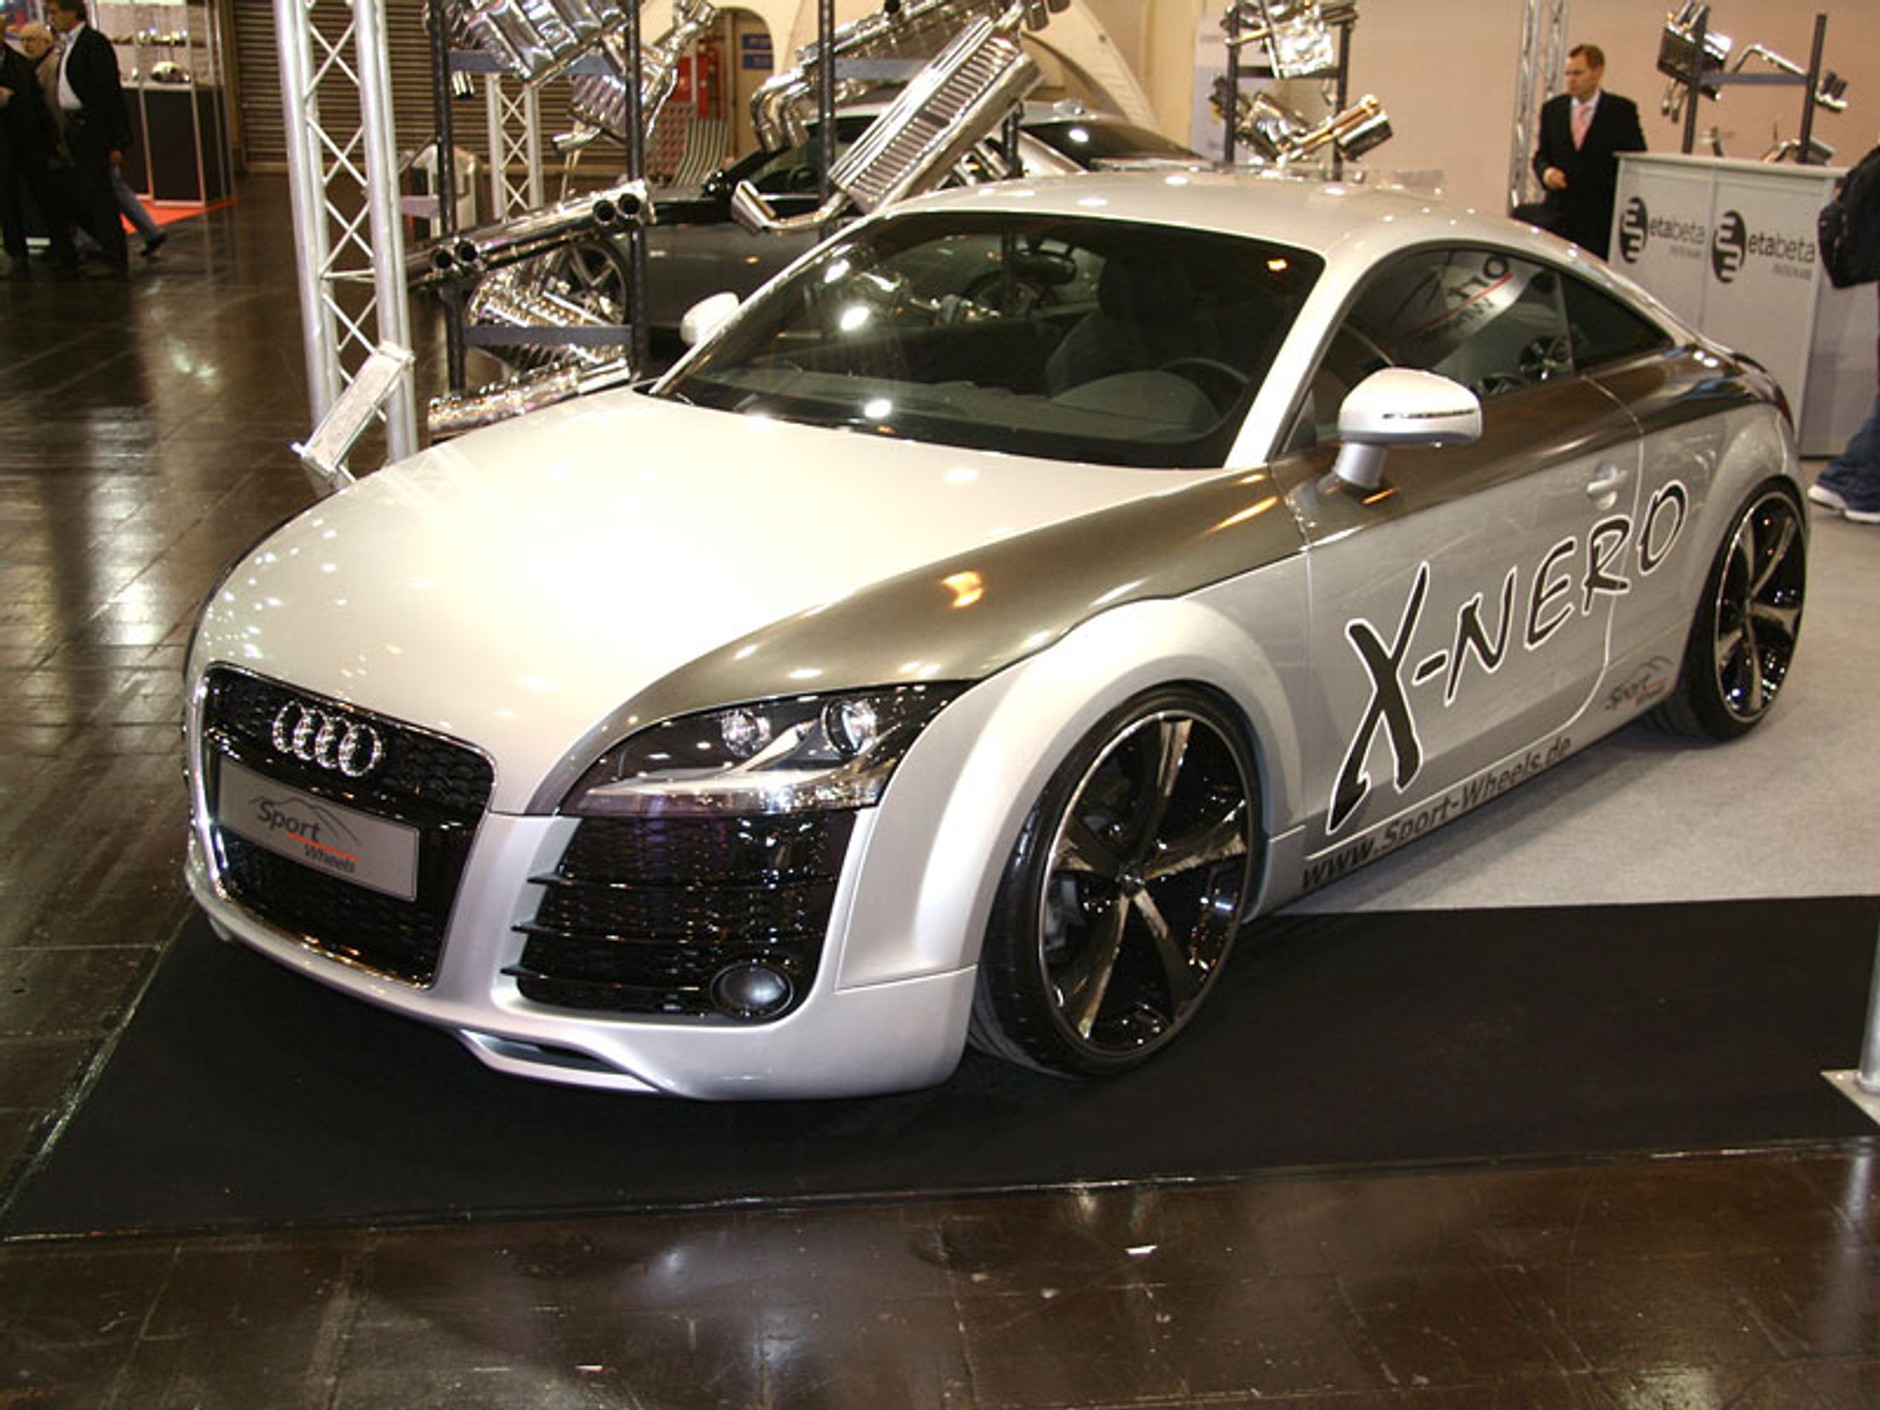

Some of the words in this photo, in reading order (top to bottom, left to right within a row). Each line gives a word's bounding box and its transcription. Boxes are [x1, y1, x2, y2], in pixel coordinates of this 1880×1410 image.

[1650, 216, 1705, 245] etabeta
[1749, 231, 1816, 264] etabeta
[1325, 479, 1689, 836] X-NERO
[257, 800, 321, 841] Sport
[1302, 736, 1572, 889] www.Sport-Wheels.de
